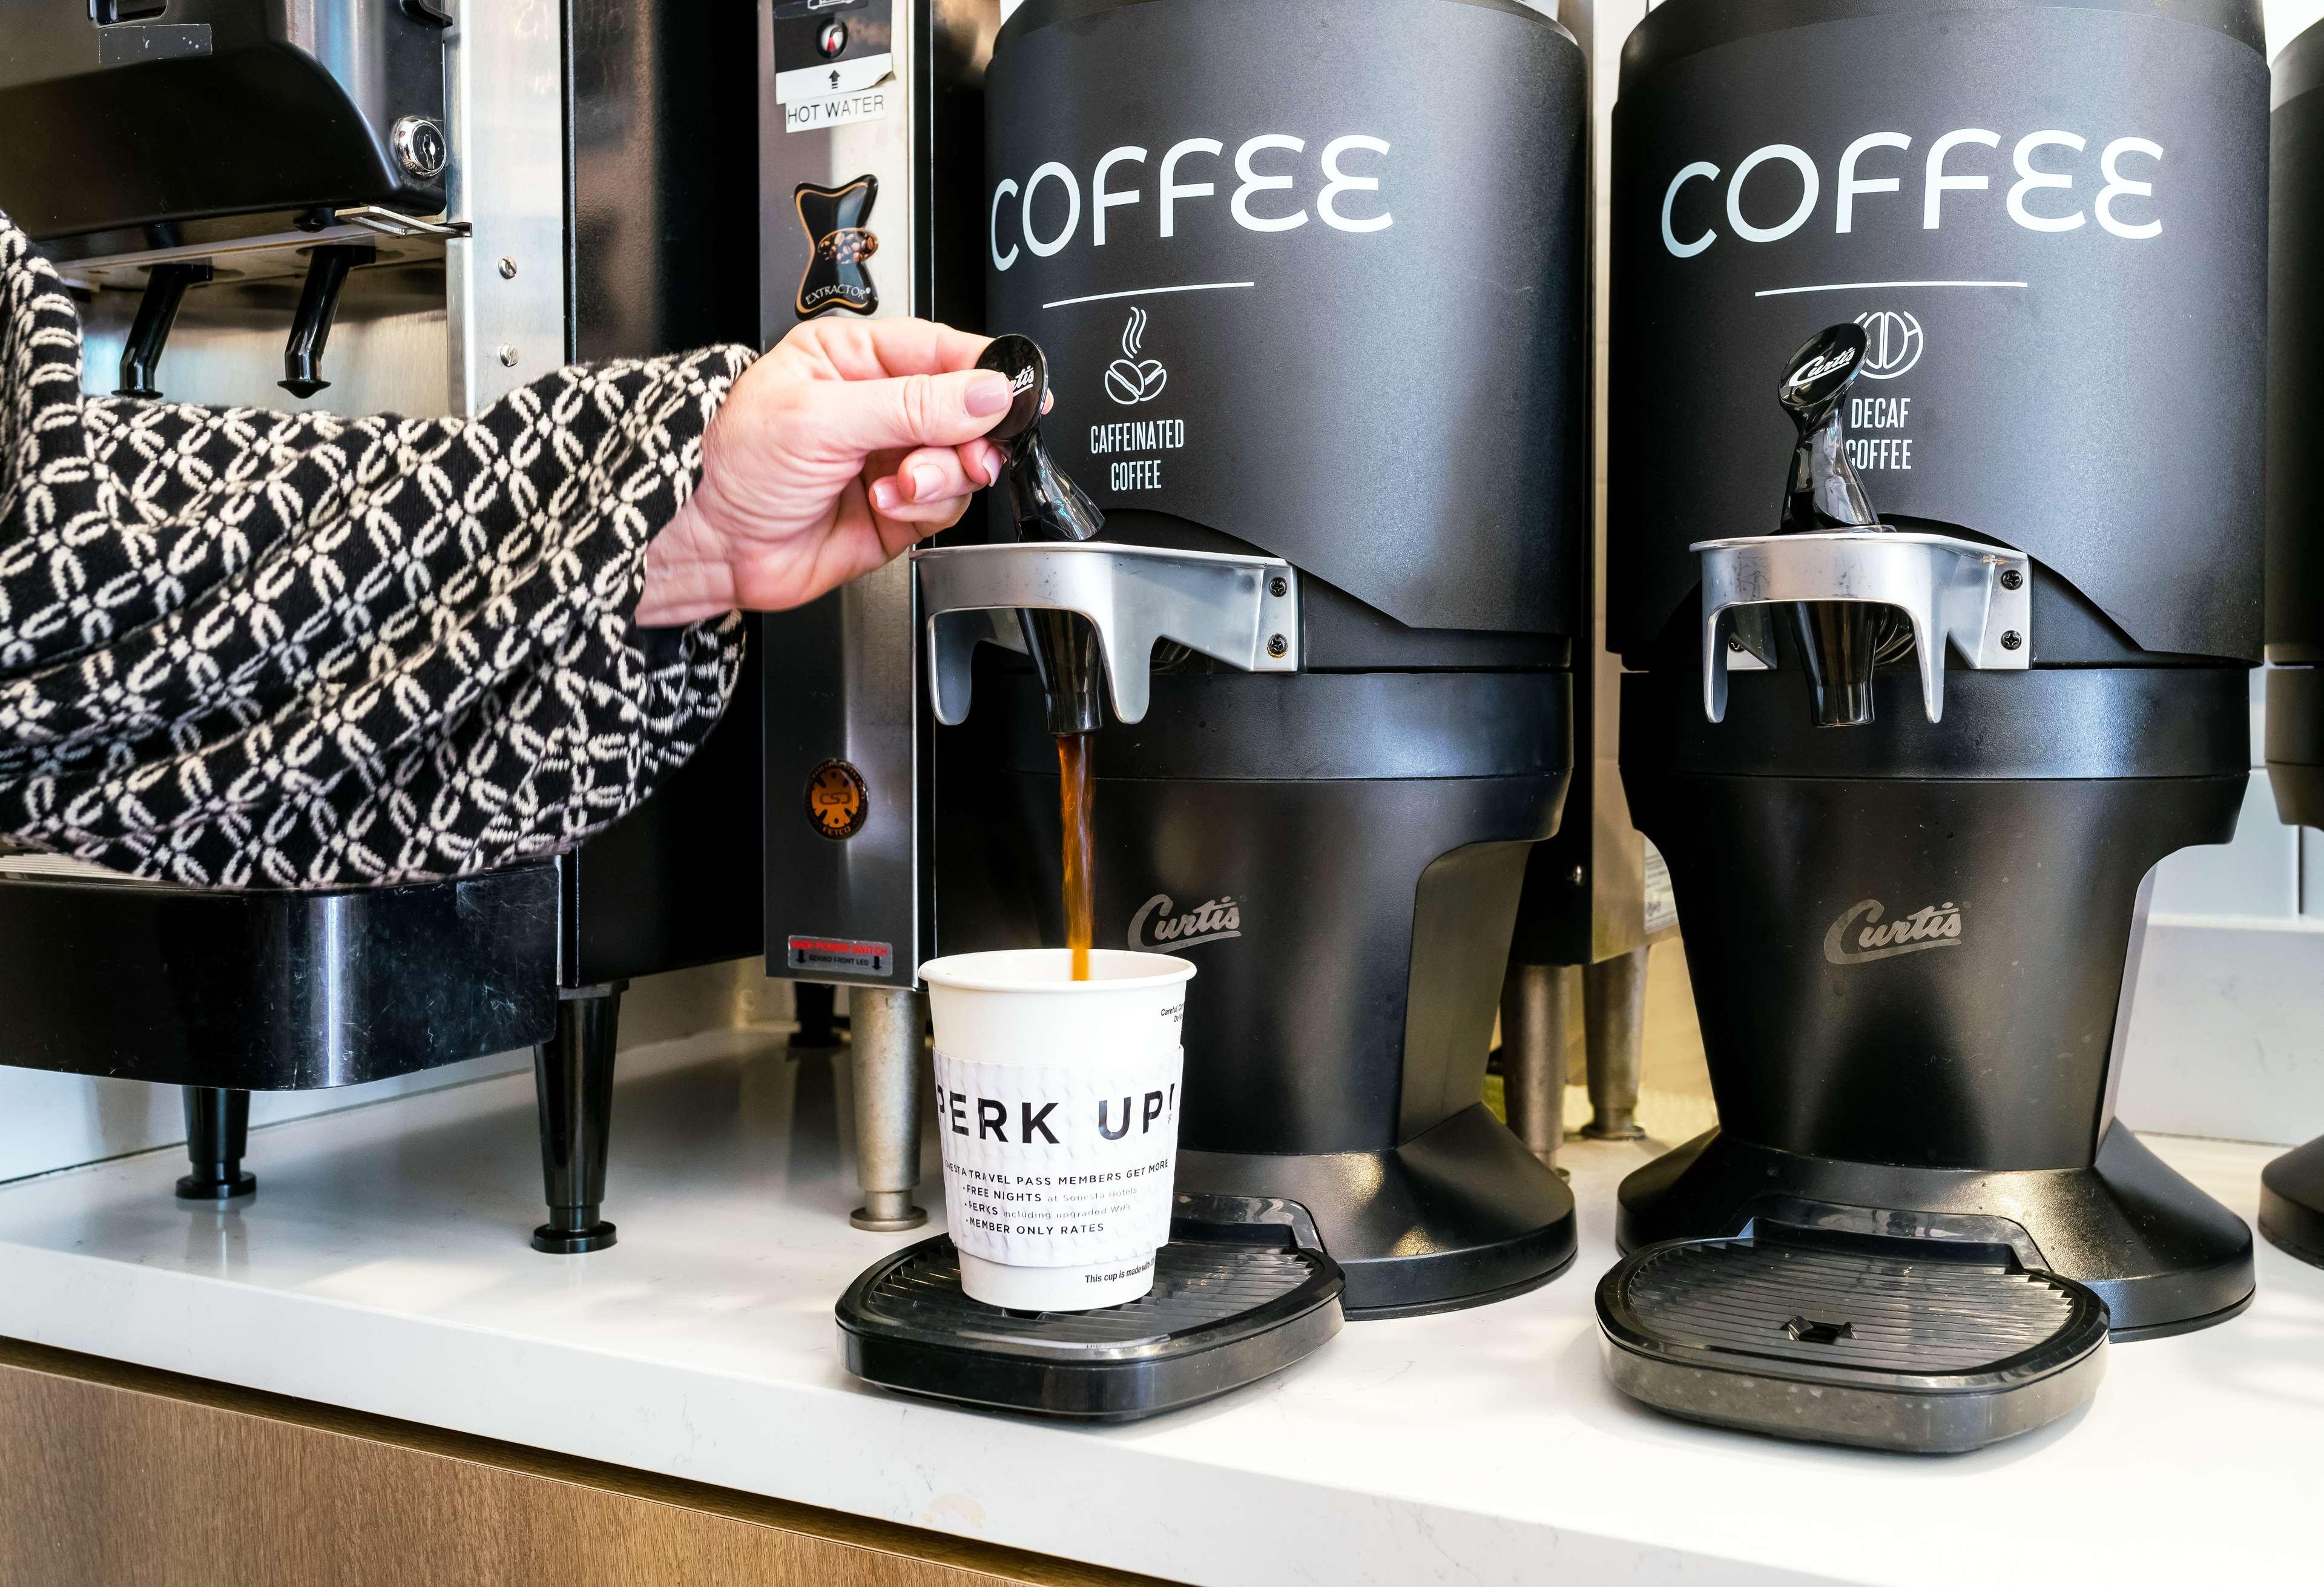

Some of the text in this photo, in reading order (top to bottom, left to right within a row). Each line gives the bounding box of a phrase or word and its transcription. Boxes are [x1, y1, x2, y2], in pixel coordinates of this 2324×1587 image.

[788, 95, 884, 124] HOT WATER
[991, 134, 1394, 271] COFFEE
[1661, 128, 2164, 259] COFFEE
[1789, 347, 1855, 387] Curtis
[1851, 398, 1911, 429] DECAF
[1090, 419, 1184, 454] CAFFEINATED
[1846, 440, 1913, 469] COFFEE
[1111, 460, 1162, 491] COFFEE
[1127, 894, 1242, 954] Curtis
[1823, 899, 1962, 965] Curtis
[834, 956, 855, 965] FRONT
[1099, 1083, 1175, 1140] UP!
[969, 1170, 1010, 1184] TRAVEL
[1017, 1176, 1051, 1186] PASS
[1058, 1172, 1121, 1185] MEMBERS
[1127, 1167, 1145, 1178] GET
[1148, 1158, 1168, 1173] MORE
[967, 1184, 989, 1198] FREE
[994, 1190, 1042, 1202] NIGHTS
[1063, 1192, 1105, 1202] Sonesta
[1109, 1187, 1137, 1198] Hotels
[969, 1201, 998, 1215] PERKS
[1056, 1207, 1107, 1219] upgraded
[970, 1216, 1104, 1235] MEMBER ONLY RATES
[1085, 1274, 1102, 1283] This
[1104, 1273, 1118, 1282] cup
[1119, 1270, 1125, 1279] is
[1127, 1265, 1141, 1277] made
